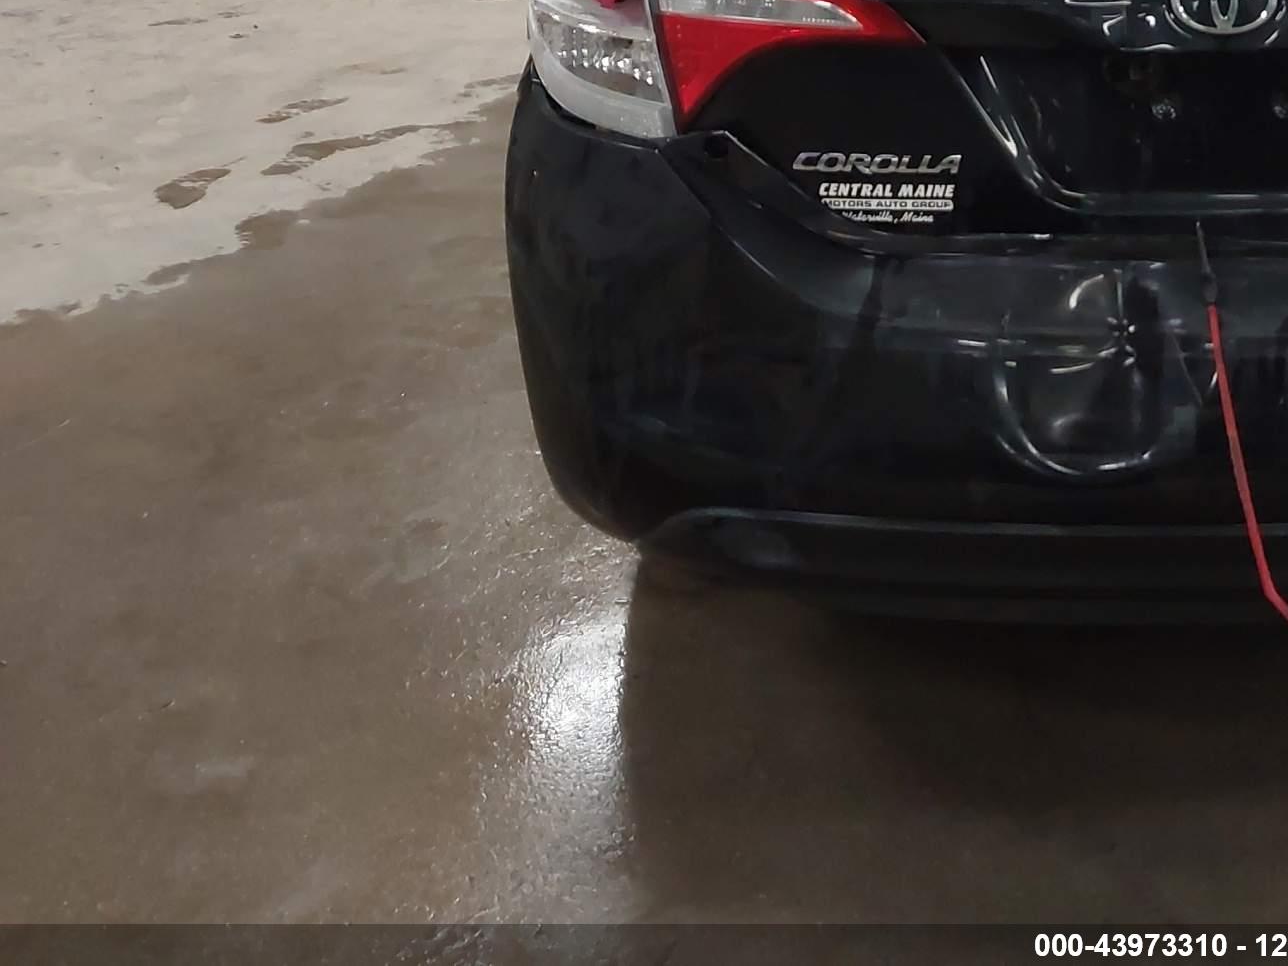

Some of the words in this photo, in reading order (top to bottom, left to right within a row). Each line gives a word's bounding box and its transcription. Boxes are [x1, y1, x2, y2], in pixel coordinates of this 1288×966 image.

[793, 151, 962, 175] COROLLA
[819, 182, 893, 197] CENTRAL
[898, 184, 955, 198] MAINE
[876, 200, 907, 208] AUTO
[911, 200, 952, 209] GROUP
[900, 212, 934, 223] Maine
